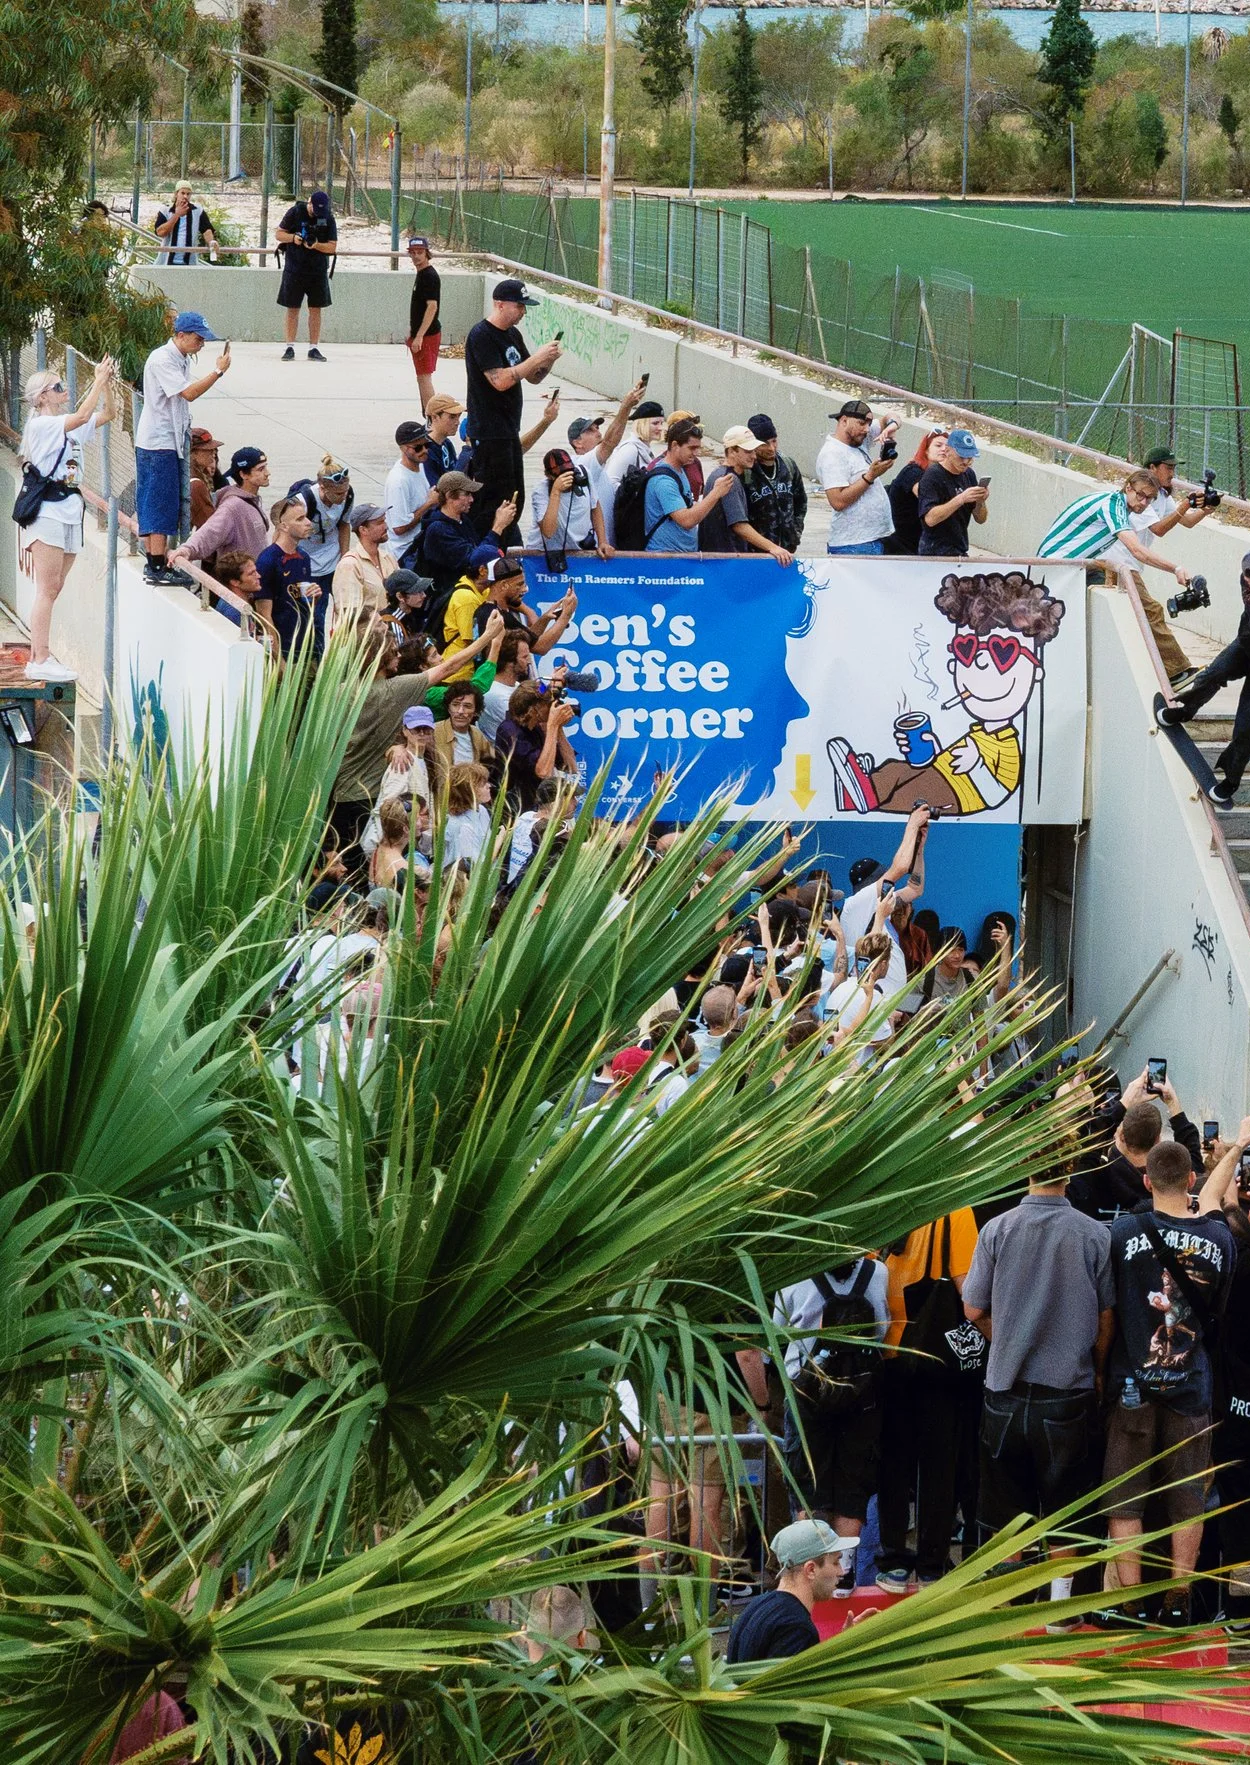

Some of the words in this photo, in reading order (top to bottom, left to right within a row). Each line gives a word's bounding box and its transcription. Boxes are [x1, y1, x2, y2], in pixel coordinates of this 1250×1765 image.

[536, 573, 558, 583] The
[561, 573, 582, 583] Ben
[584, 574, 635, 585] Raemers
[637, 575, 705, 586] Foundation
[537, 648, 730, 692] Coffee
